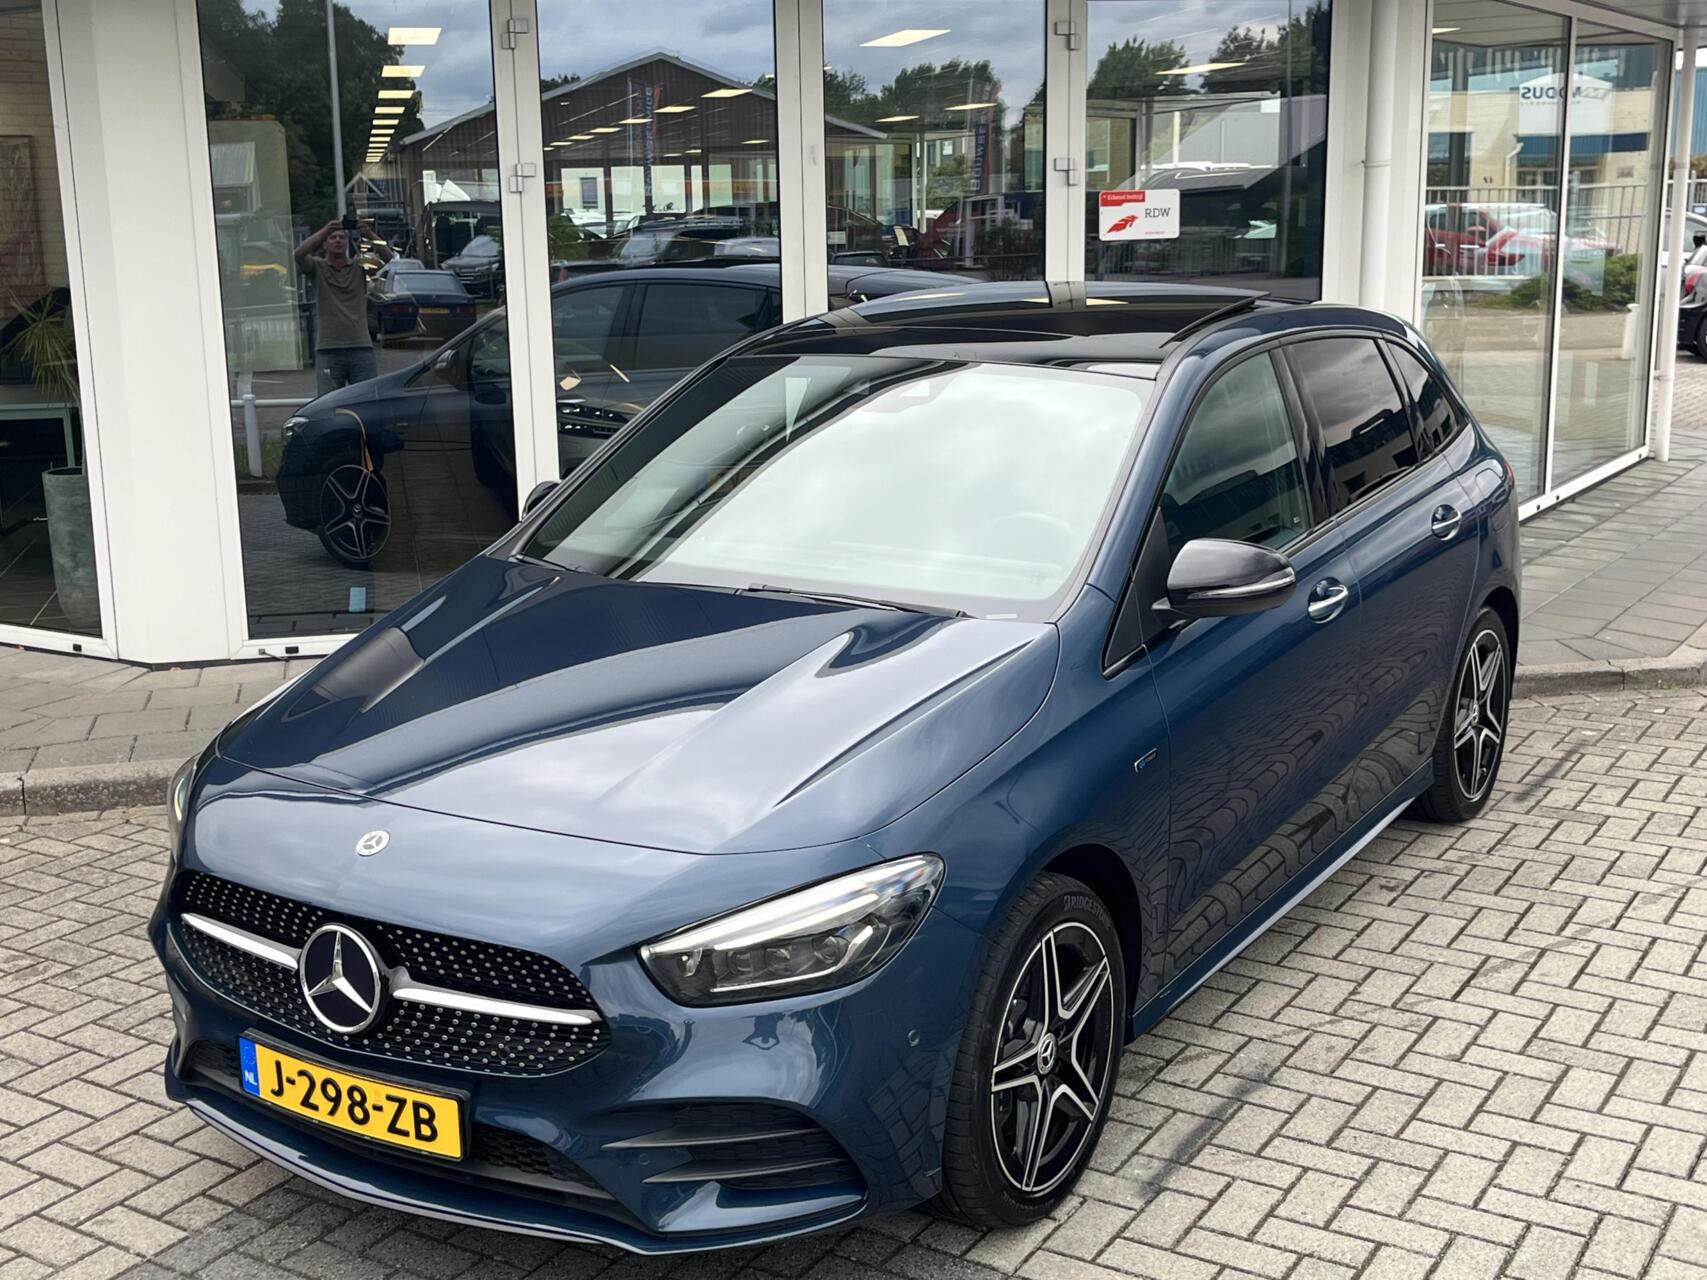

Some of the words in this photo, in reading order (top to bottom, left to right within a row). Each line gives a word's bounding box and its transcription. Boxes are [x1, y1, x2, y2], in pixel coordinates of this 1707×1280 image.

[1145, 207, 1170, 218] RDW
[245, 1070, 257, 1085] NL
[270, 1059, 438, 1142] J-298-ZB
